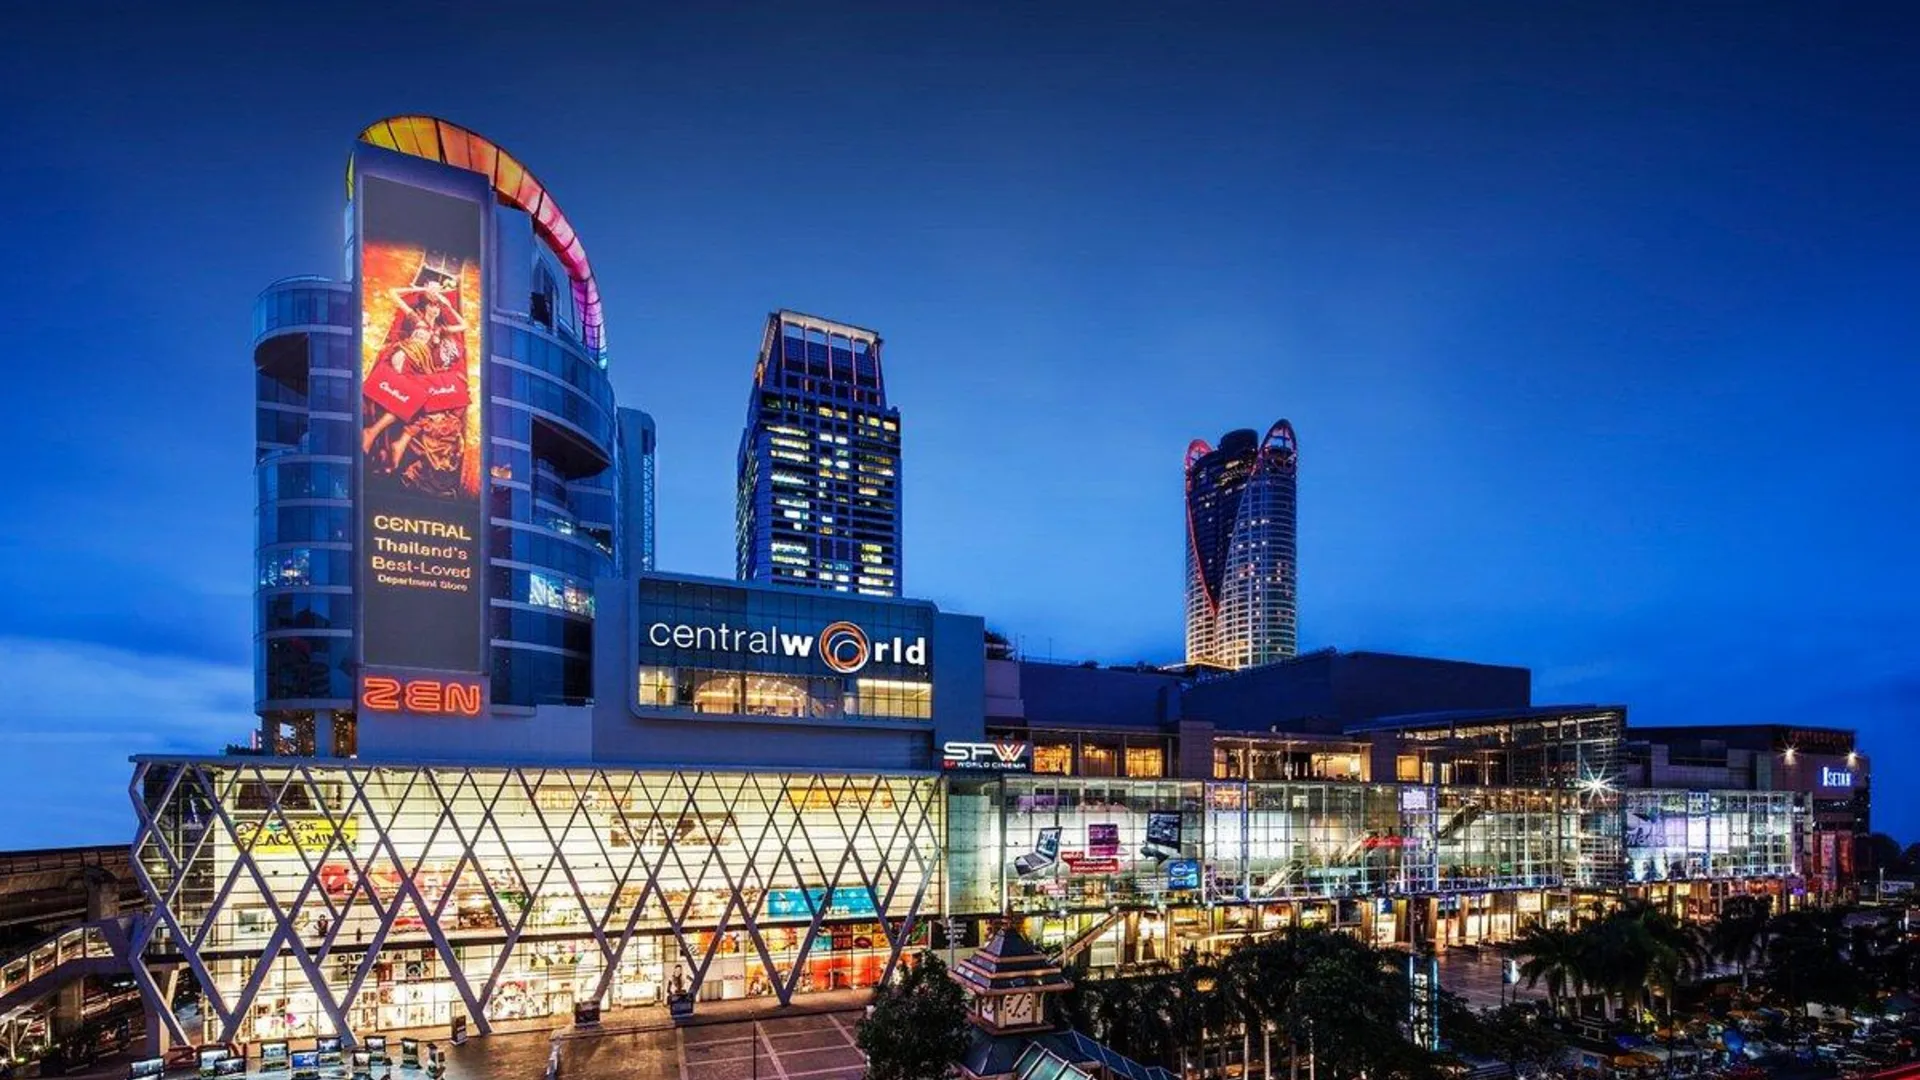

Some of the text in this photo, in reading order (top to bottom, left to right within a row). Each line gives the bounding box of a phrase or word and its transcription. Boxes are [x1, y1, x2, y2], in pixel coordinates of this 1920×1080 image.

[374, 515, 472, 541] CENTRAL
[374, 537, 468, 560] Thailand's
[372, 556, 471, 579] Best-Loved
[377, 574, 468, 592] Department Store
[363, 678, 481, 714] ZEN
[943, 742, 1026, 761] SFW
[957, 761, 991, 769] WORLD
[991, 761, 1027, 770] CINEMA
